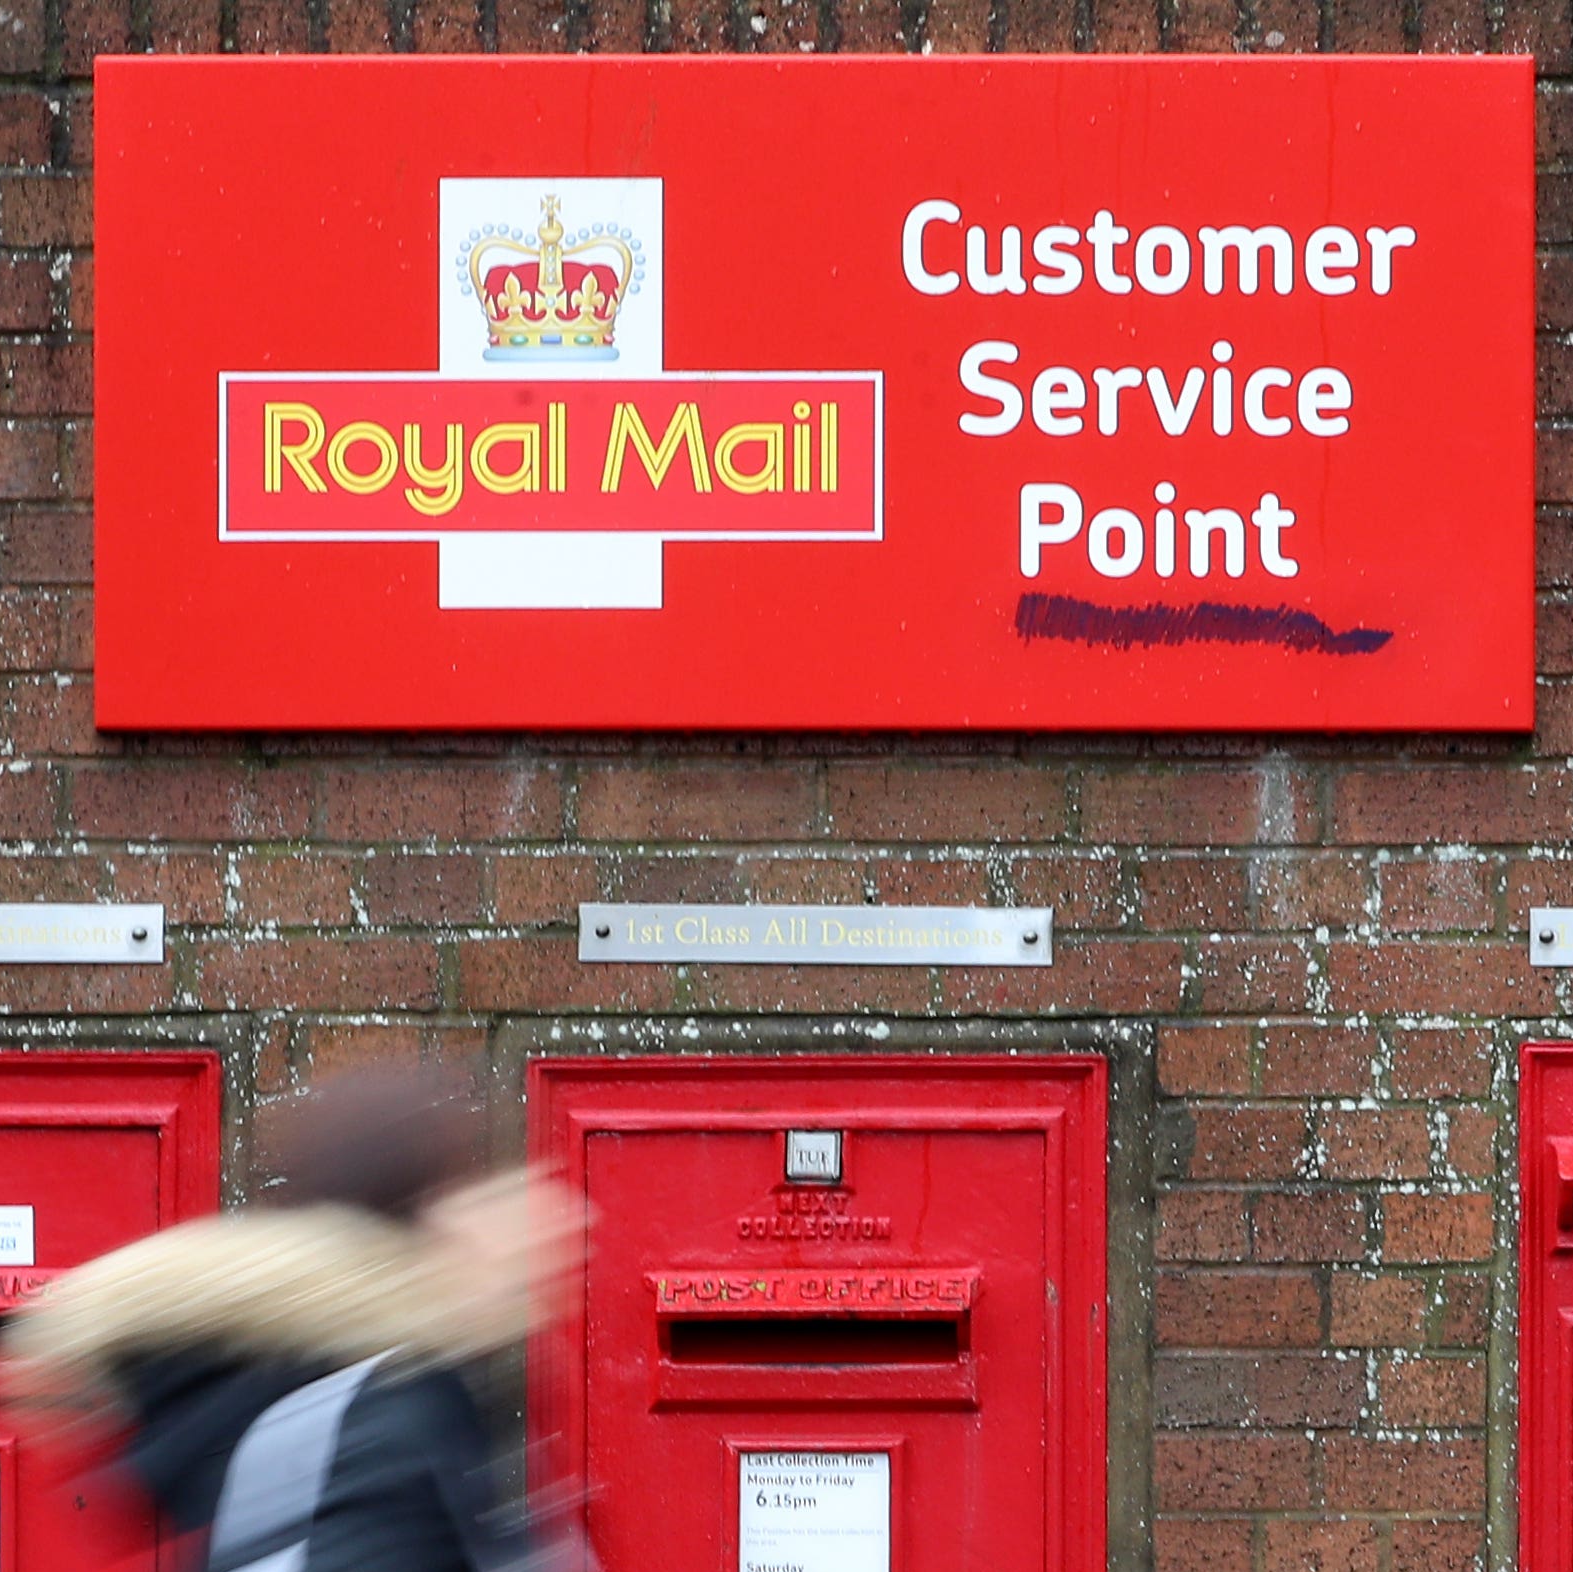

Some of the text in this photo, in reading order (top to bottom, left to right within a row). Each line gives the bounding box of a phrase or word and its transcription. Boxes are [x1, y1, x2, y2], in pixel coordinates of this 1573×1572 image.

[901, 201, 1415, 295] Customer
[959, 343, 1353, 438] Service
[264, 403, 838, 515] Royal Mail
[1020, 483, 1298, 578] Point
[627, 918, 1003, 946] 1st Class All Destinations
[777, 1193, 851, 1215] NEXT
[738, 1216, 891, 1240] COLLECTION
[662, 1278, 969, 1301] POST OFFICE
[746, 1453, 875, 1468] Last Collection Time
[746, 1474, 855, 1487] Monday to Friday
[756, 1490, 817, 1511] 6.15pm
